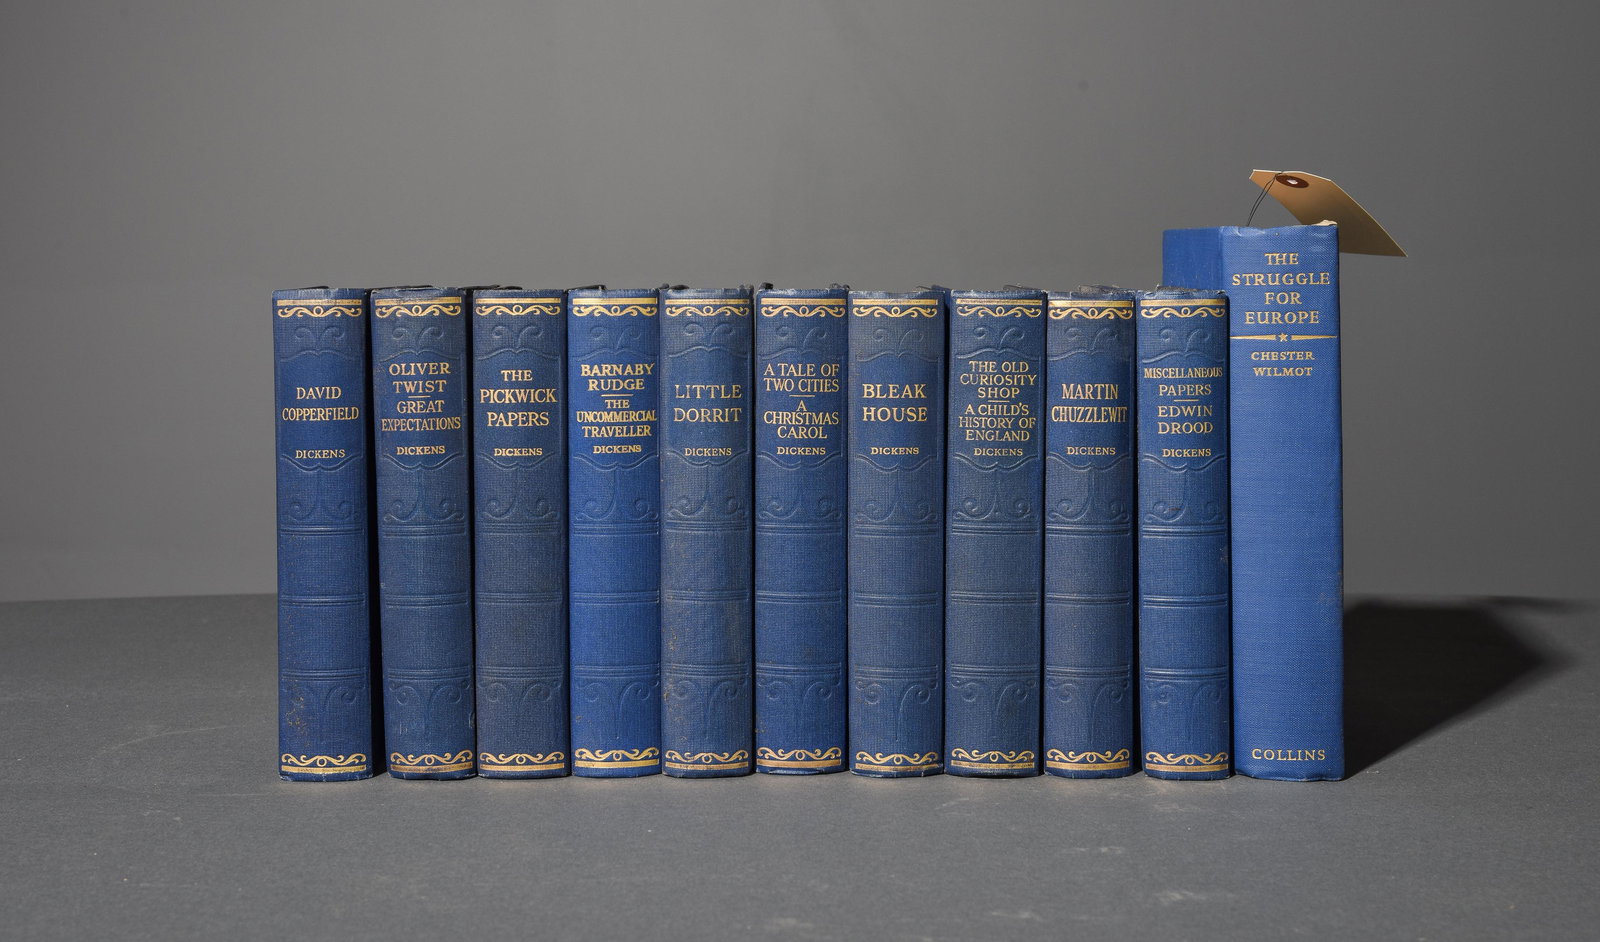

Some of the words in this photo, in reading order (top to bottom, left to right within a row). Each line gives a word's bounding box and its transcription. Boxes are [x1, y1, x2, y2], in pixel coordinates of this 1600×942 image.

[1264, 253, 1298, 264] THE
[1232, 272, 1331, 286] STRUGGLE
[1265, 292, 1302, 304] FOR
[1246, 310, 1320, 325] EUROPE
[1251, 351, 1315, 361] CHESTER
[389, 362, 452, 375] OLIVER
[581, 363, 654, 376] BARNABY
[765, 363, 775, 377] A
[779, 363, 816, 377] TALE
[820, 363, 839, 377] OF
[969, 360, 996, 372] THE
[1001, 360, 1029, 372] OLD
[1254, 367, 1312, 376] WILMOT
[500, 369, 532, 381] THE
[1145, 368, 1222, 378] MISCELLANEOUS
[588, 378, 644, 390] RUDGE
[764, 378, 795, 392] TWO
[798, 378, 840, 392] CITIES
[960, 374, 1036, 385] CURIOSITY
[392, 379, 447, 393] TWIST
[675, 384, 743, 398] LITTLE
[863, 384, 927, 399] BLEAK
[1062, 384, 1118, 400] MARTIN
[1159, 384, 1212, 395] PAPERS
[297, 387, 342, 399] DAVID
[480, 388, 558, 404] PICKWICK
[977, 387, 1020, 399] SHOP
[397, 400, 444, 413] GREAT
[605, 399, 629, 408] THE
[797, 400, 807, 411] A
[964, 404, 976, 416] A
[978, 402, 1030, 416] CHILD'S
[282, 406, 359, 421] COPPERFIELD
[577, 410, 656, 422] UNCOMMERCIAL
[674, 408, 742, 422] DORRIT
[863, 406, 928, 422] HOUSE
[1051, 406, 1128, 423] CHUZZLEWIT
[1158, 405, 1212, 417] EDWIN
[382, 416, 461, 431] EXPECTATIONS
[487, 411, 550, 427] PAPERS
[764, 410, 840, 425] CHRISTMAS
[959, 415, 1016, 428] HISTORY
[1018, 415, 1036, 428] OF
[582, 425, 651, 437] TRAVELLER
[777, 426, 828, 439] CAROL
[1158, 422, 1213, 434] DROOD
[965, 429, 1030, 441] ENGLAND
[296, 450, 346, 458] DICKENS
[396, 445, 446, 455] DICKENS
[494, 448, 543, 456] DICKENS
[593, 445, 642, 453] DICKENS
[685, 448, 732, 456] DICKENS
[777, 447, 826, 455] DICKENS
[871, 447, 919, 455] DICKENS
[974, 448, 1023, 456] DICKENS
[1067, 446, 1116, 455] DICKENS
[1163, 448, 1211, 457] DICKENS
[1252, 748, 1325, 760] COLLINS
